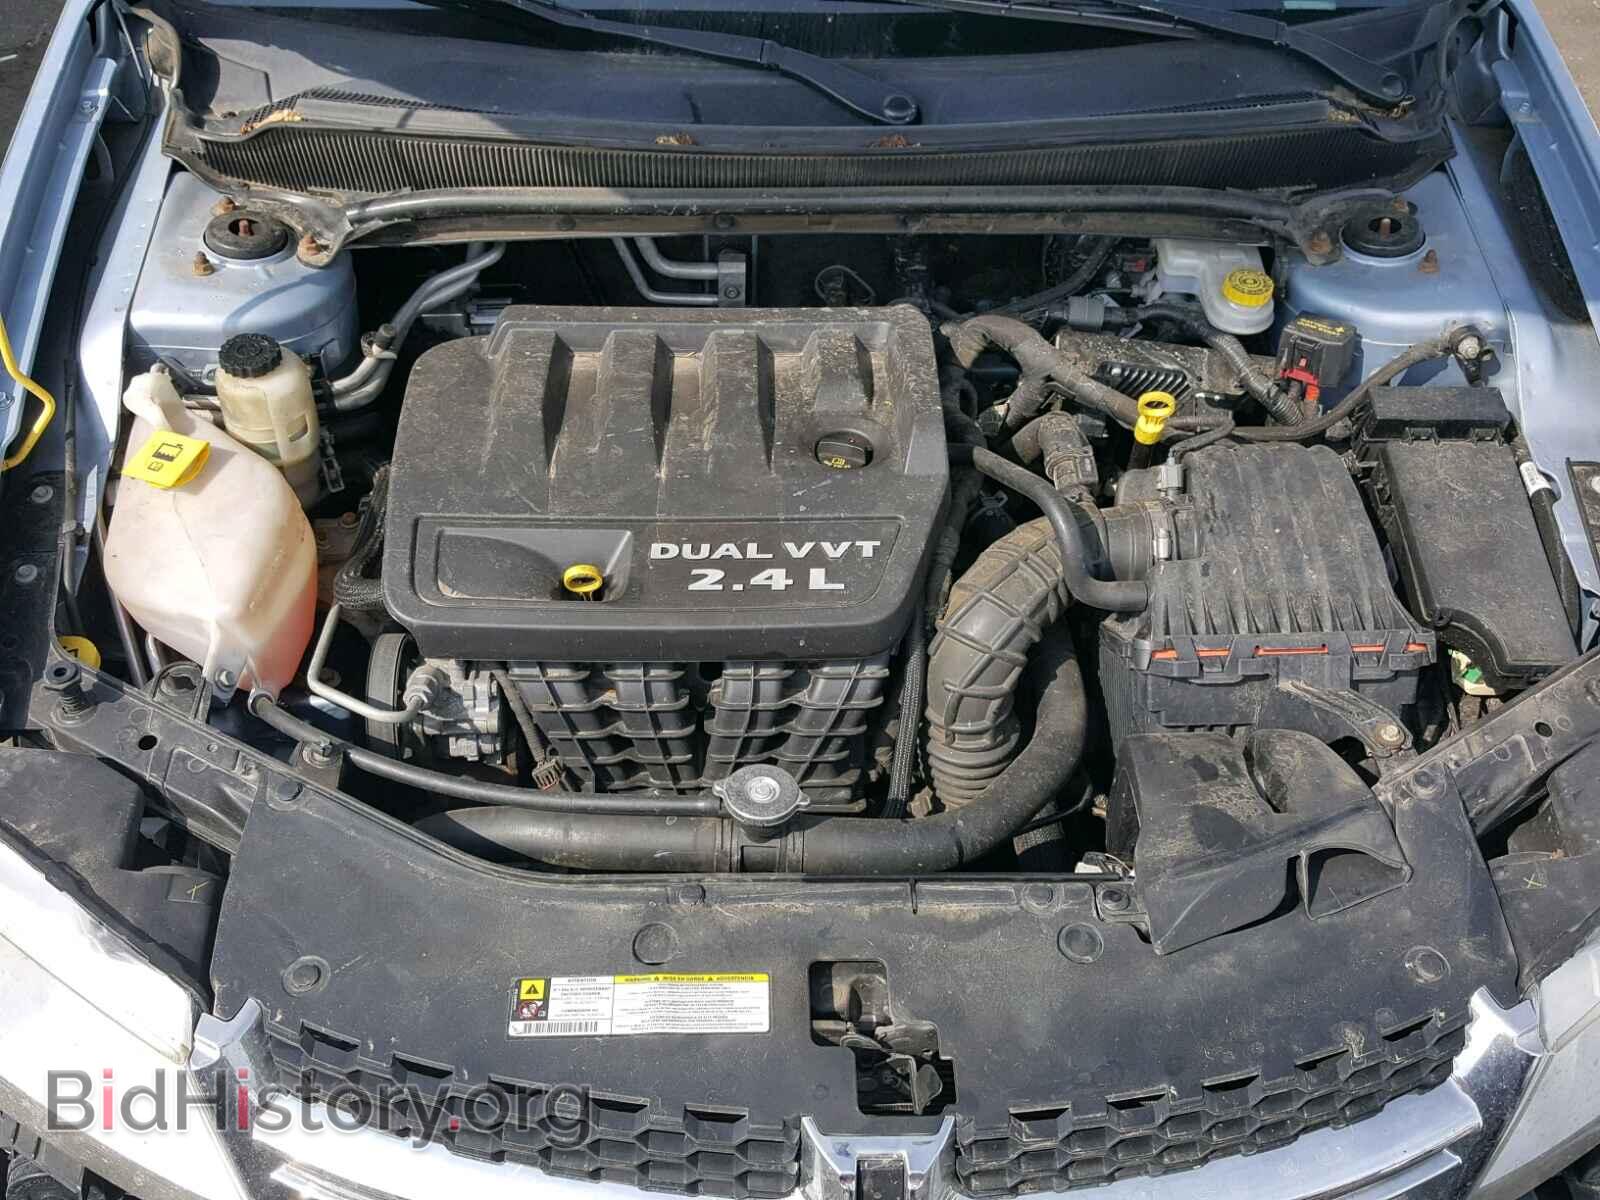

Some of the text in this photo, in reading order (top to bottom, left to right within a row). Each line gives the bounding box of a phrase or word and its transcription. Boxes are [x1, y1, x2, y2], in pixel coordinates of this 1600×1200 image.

[650, 541, 881, 560] DUAL VVT
[687, 568, 794, 591] 2.4
